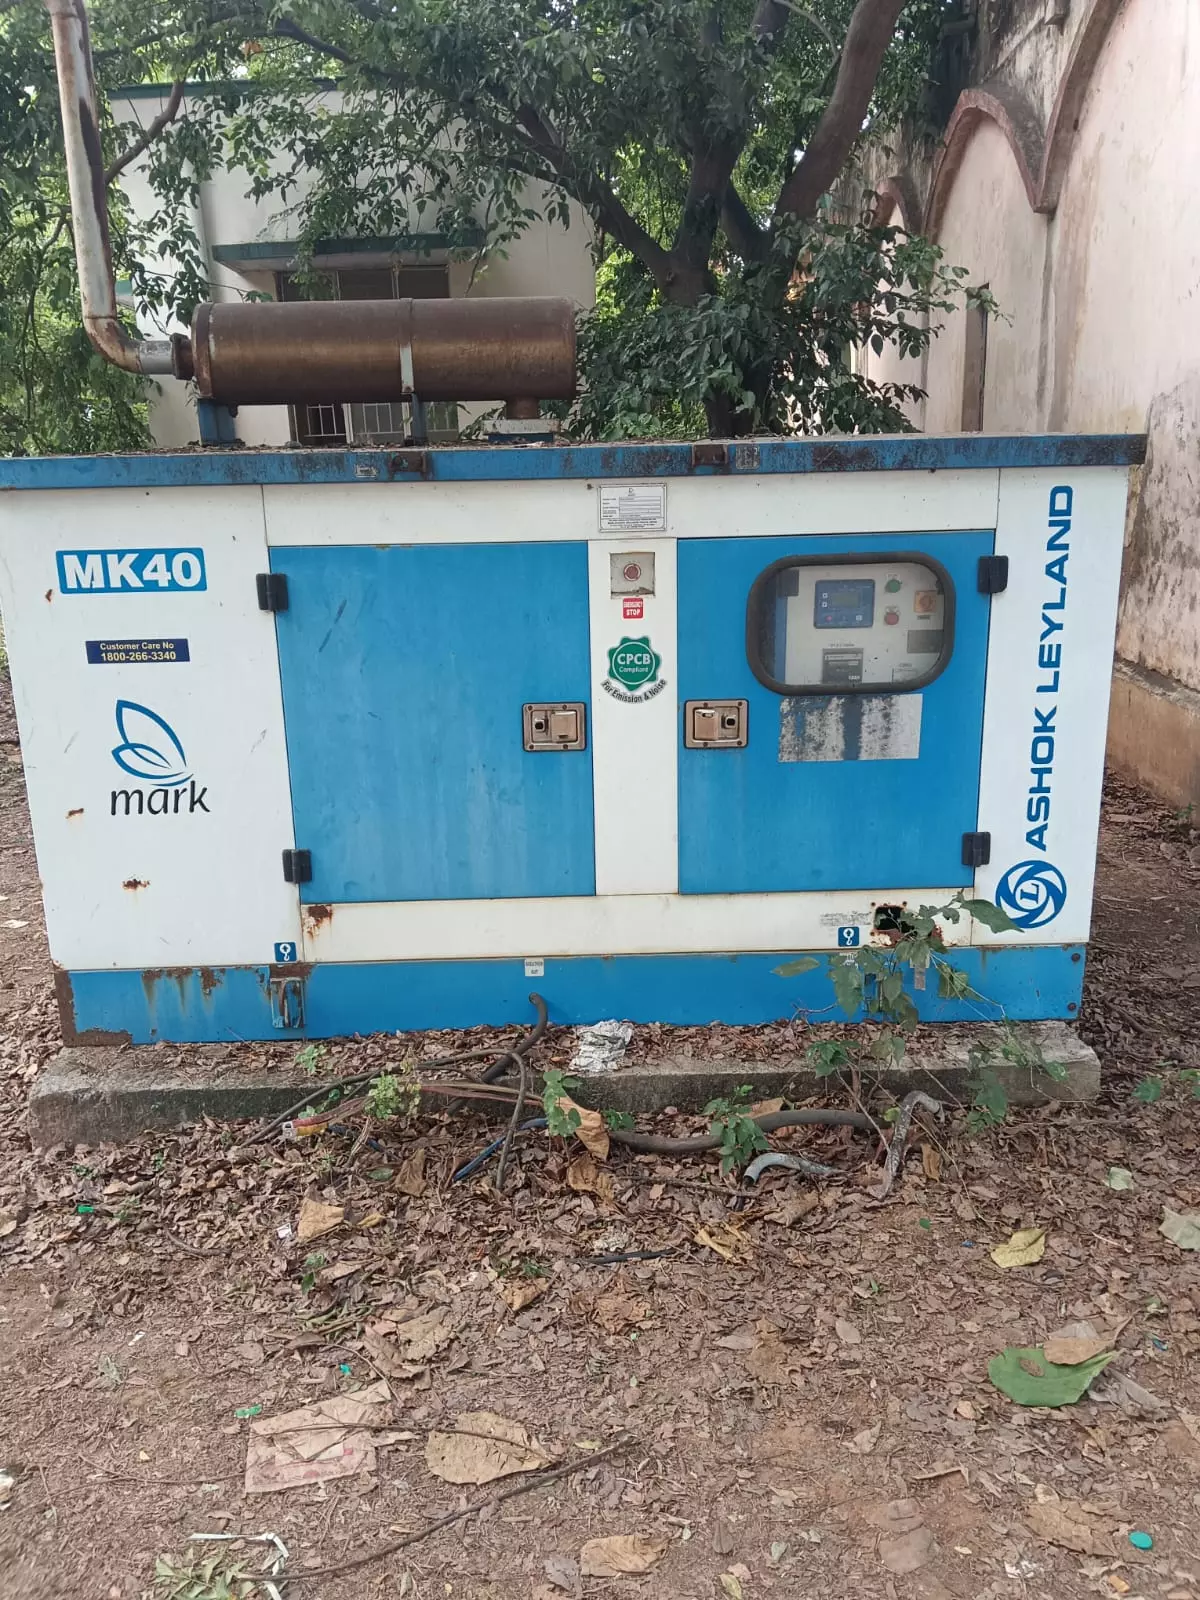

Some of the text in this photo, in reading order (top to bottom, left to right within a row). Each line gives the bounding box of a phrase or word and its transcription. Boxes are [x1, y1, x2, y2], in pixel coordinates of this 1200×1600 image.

[63, 552, 202, 588] MK40
[100, 641, 174, 651] Customer Care No
[101, 651, 176, 661] 1800-266-3340
[616, 653, 650, 665] CPCB
[618, 666, 649, 674] Compliant
[1025, 485, 1073, 852] ASHOK LEYLAND
[601, 679, 613, 693] For
[611, 689, 643, 703] Emission
[648, 679, 667, 697] Noise
[111, 780, 210, 815] mark
